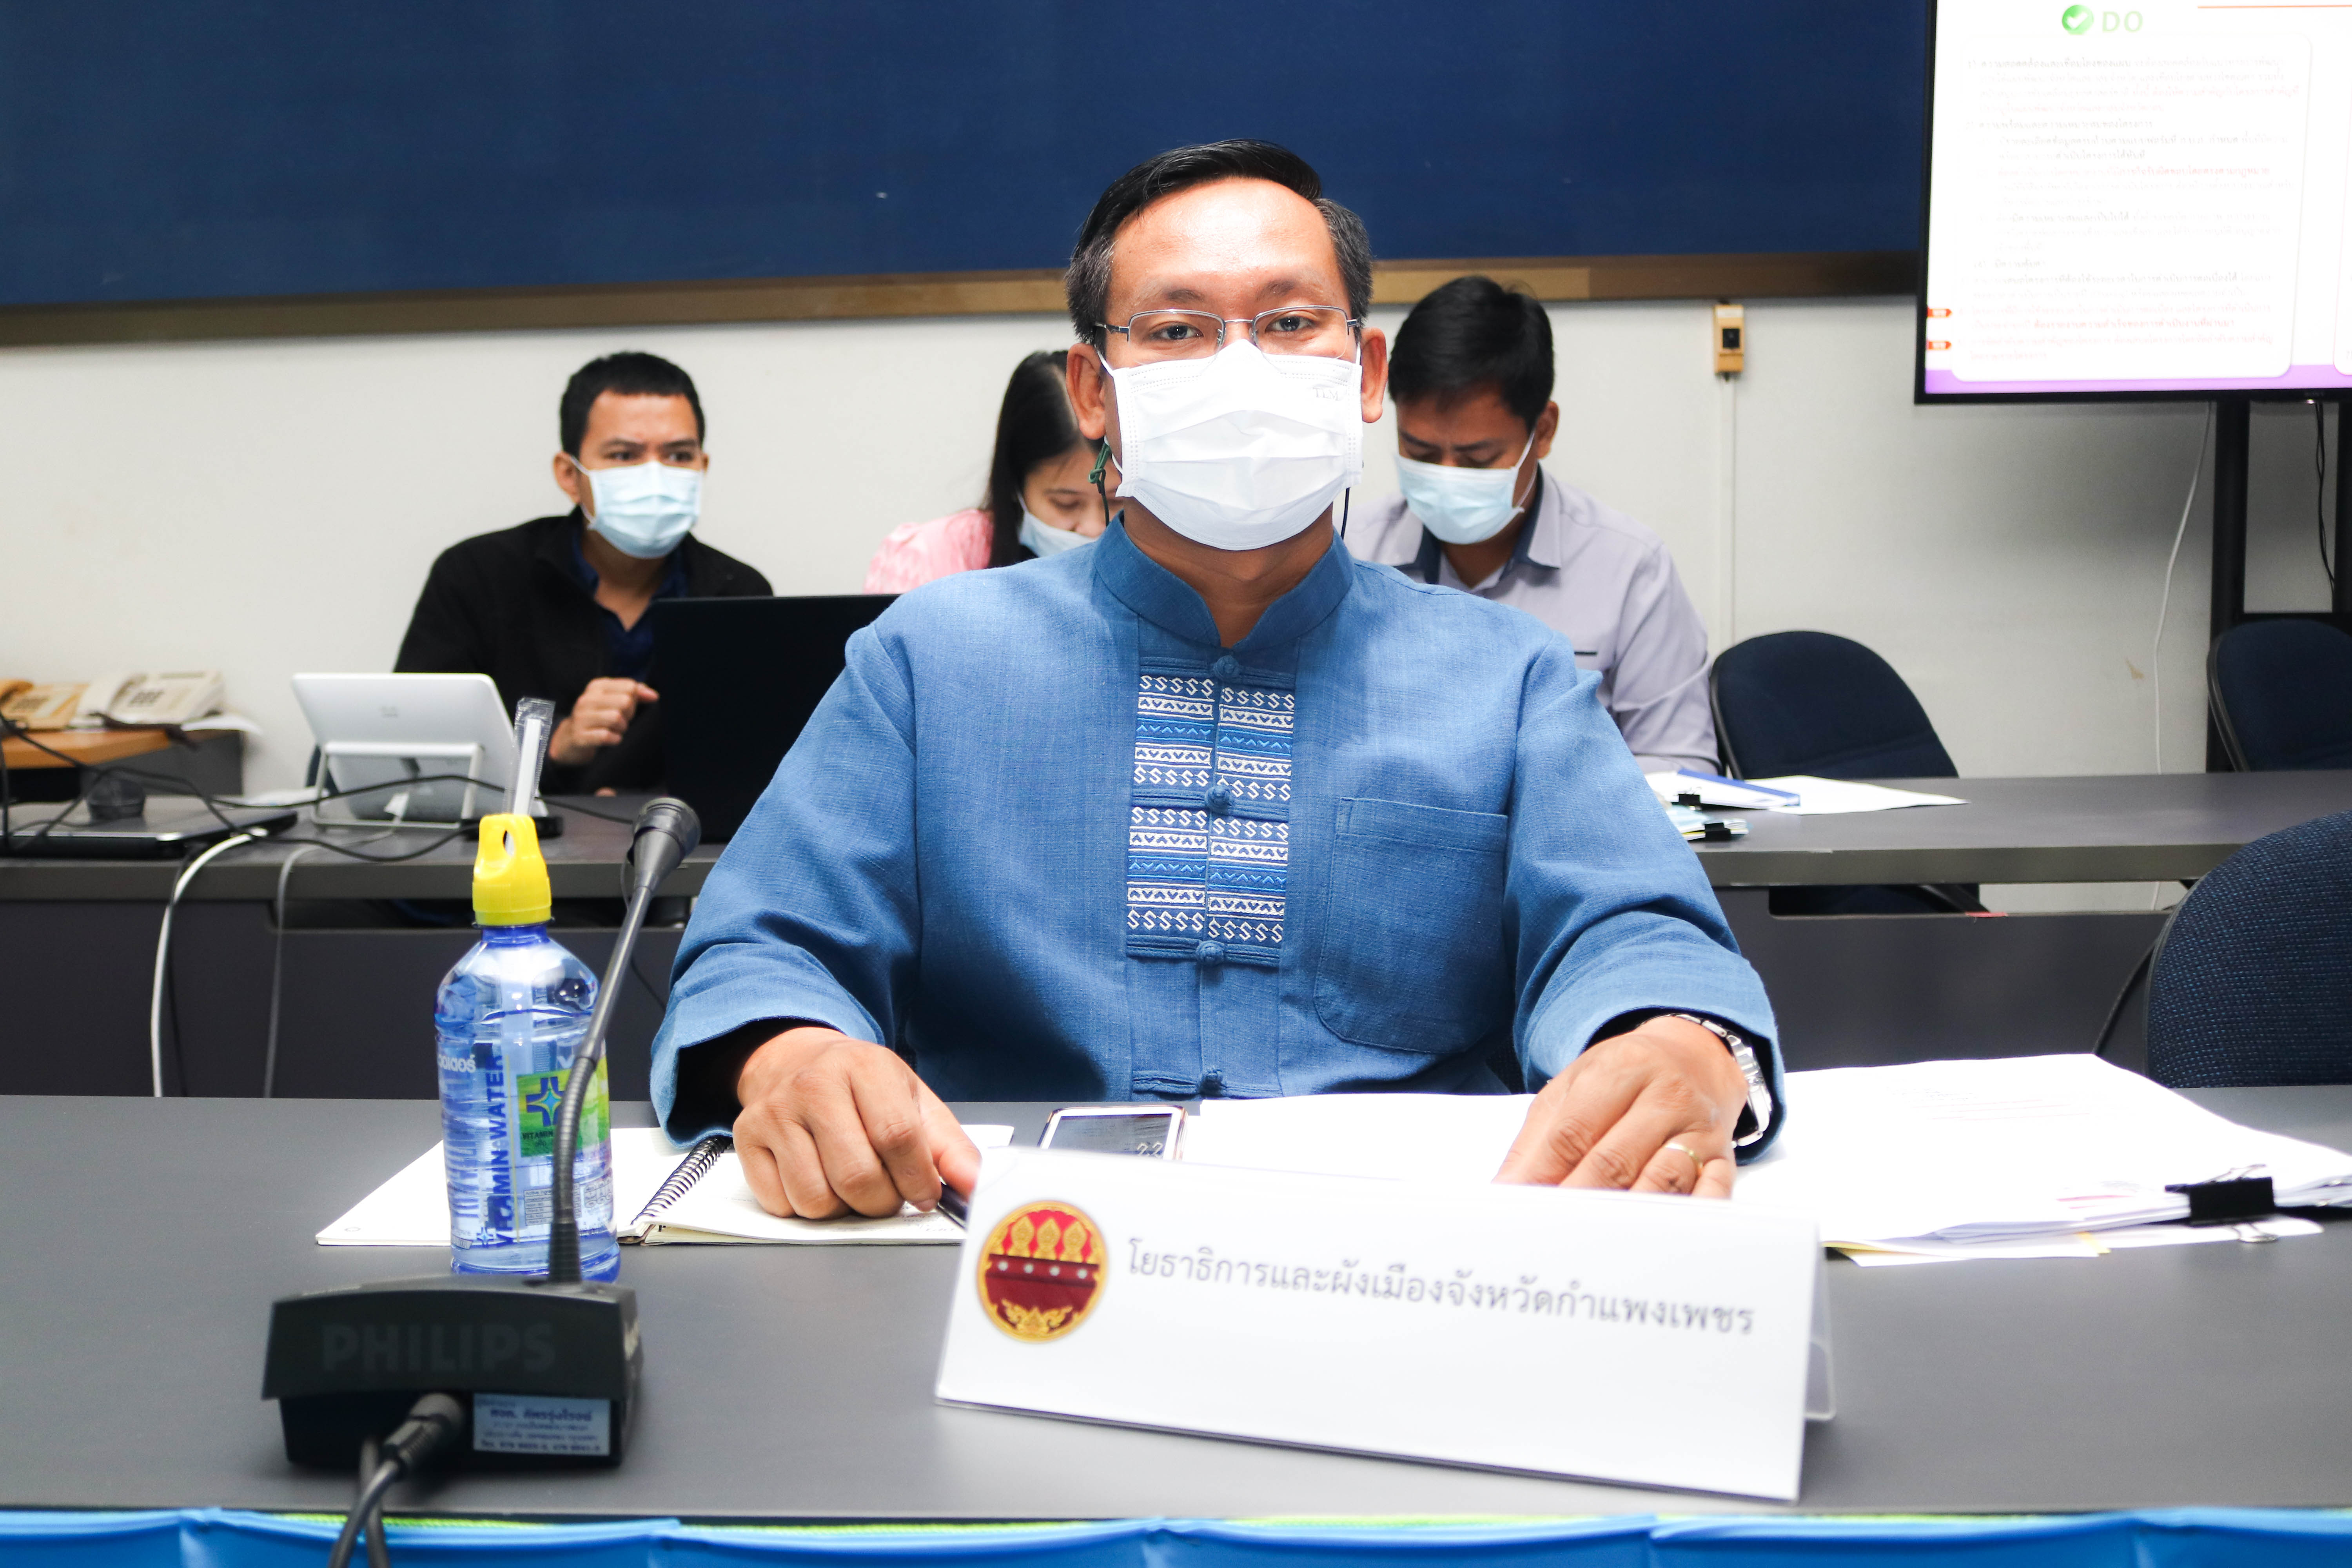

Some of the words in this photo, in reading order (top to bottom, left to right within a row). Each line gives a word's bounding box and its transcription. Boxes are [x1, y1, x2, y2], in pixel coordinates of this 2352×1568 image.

[2102, 11, 2143, 33] DO
[485, 1056, 507, 1140] WATER
[491, 1150, 513, 1248] VITAMIN
[1128, 1238, 1755, 1334] โยธาธิการและผังเมืองจังหวัดกำแพงเพชร
[323, 1323, 557, 1374] PHILIPS
